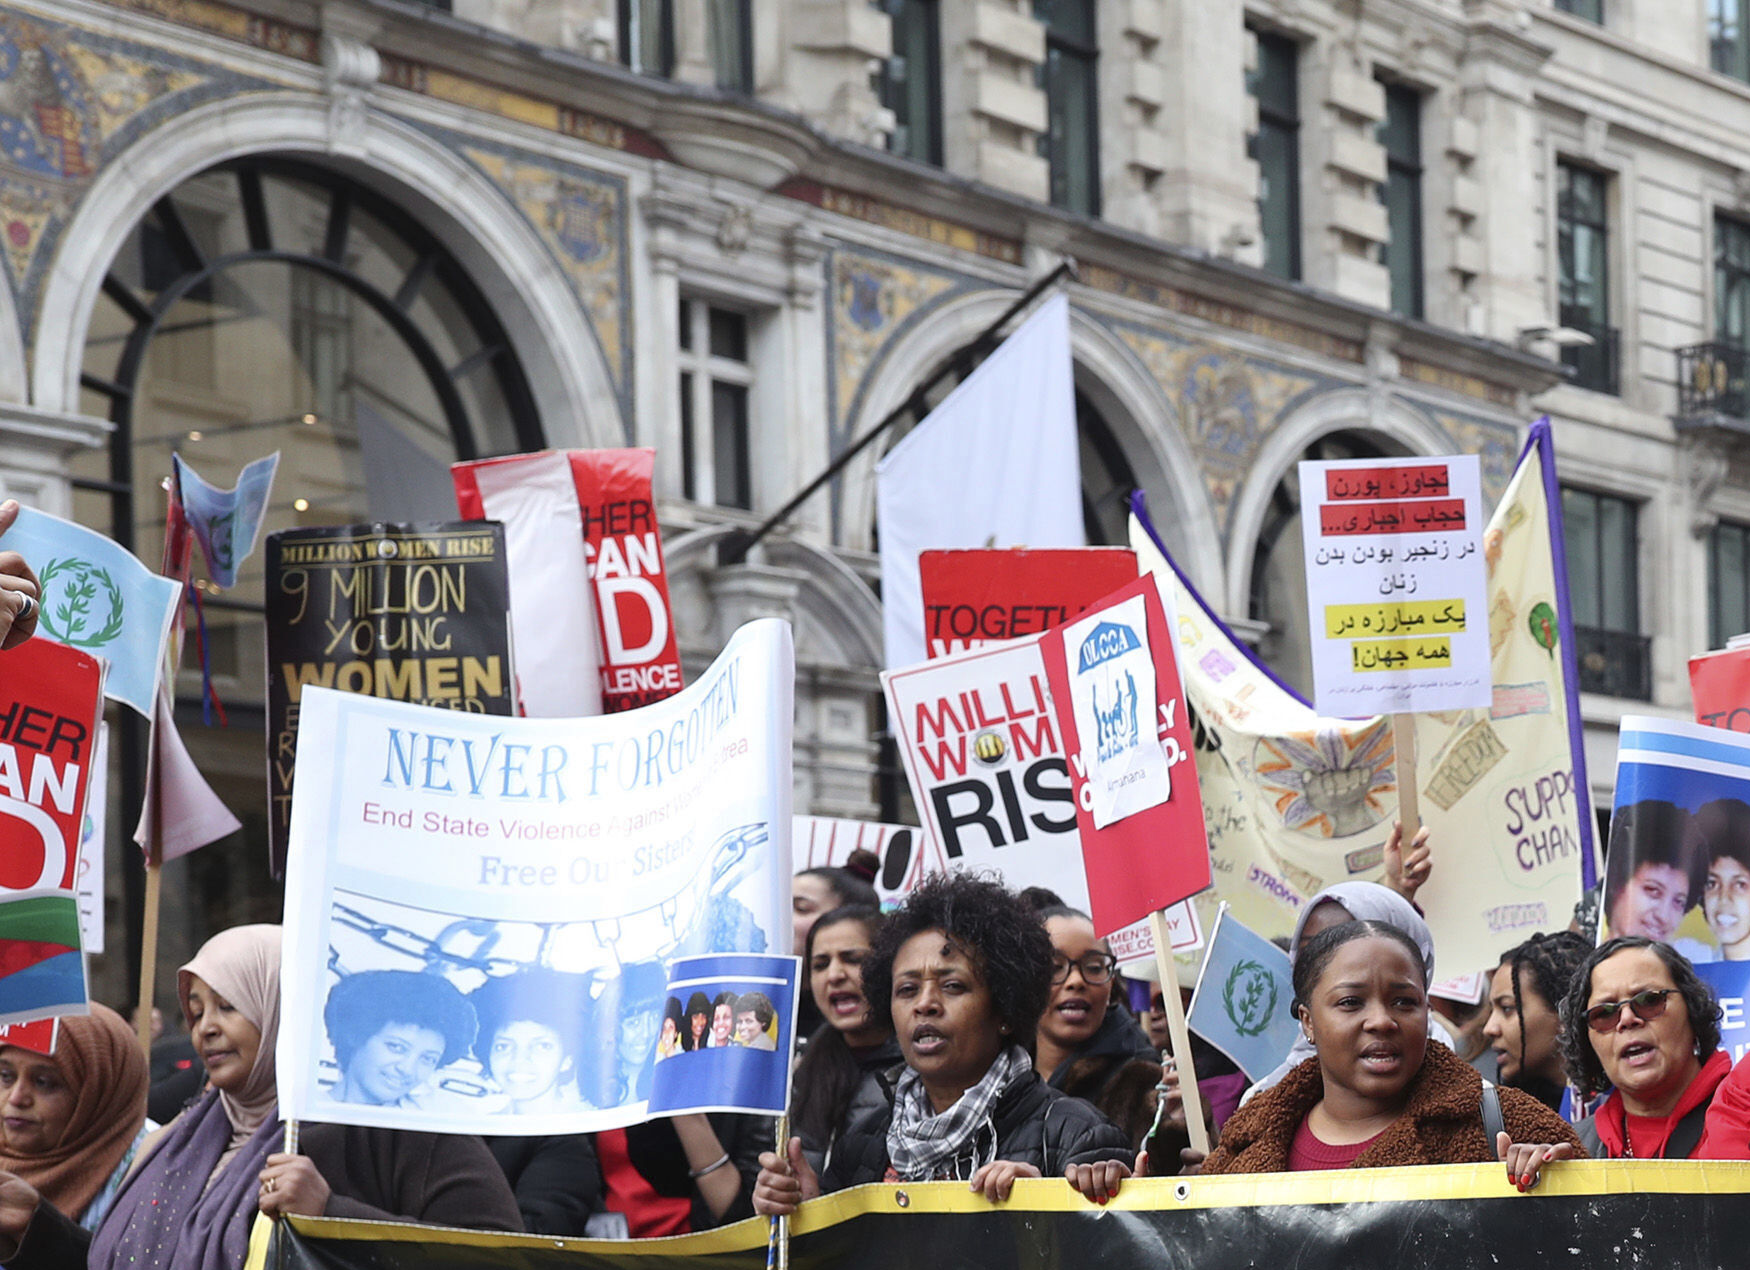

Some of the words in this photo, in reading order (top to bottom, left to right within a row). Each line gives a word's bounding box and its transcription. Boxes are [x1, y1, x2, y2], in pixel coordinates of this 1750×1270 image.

[1413, 505, 1466, 527] حجاب
[281, 544, 366, 564] MILLION
[366, 539, 441, 560] WOMEN
[446, 536, 495, 557] RISE
[1315, 545, 1346, 567] بدن
[1352, 547, 1394, 564] بودن
[1401, 539, 1450, 563] زنجیر
[1456, 542, 1476, 560] در
[329, 564, 466, 621] MILLION
[1379, 573, 1417, 595] زنان
[927, 604, 1090, 638] TOGET
[1334, 615, 1355, 635] در
[1361, 608, 1425, 634] مبارزه
[1432, 604, 1467, 629] یک
[324, 616, 452, 656] YOUNG
[1416, 642, 1450, 661] همه
[282, 655, 503, 702] WOMEN
[603, 664, 680, 695] LENCE
[916, 675, 1048, 744] MILLI
[381, 727, 570, 804] NEVER
[588, 656, 741, 796] FORGOTTEN
[918, 715, 1059, 782] WOM
[930, 757, 1080, 859] RIS
[1505, 766, 1576, 836] SUPP
[362, 801, 413, 829] End
[423, 811, 490, 839] State
[500, 818, 600, 841] Violence
[1516, 824, 1577, 872] CHAN
[477, 854, 558, 887] Free
